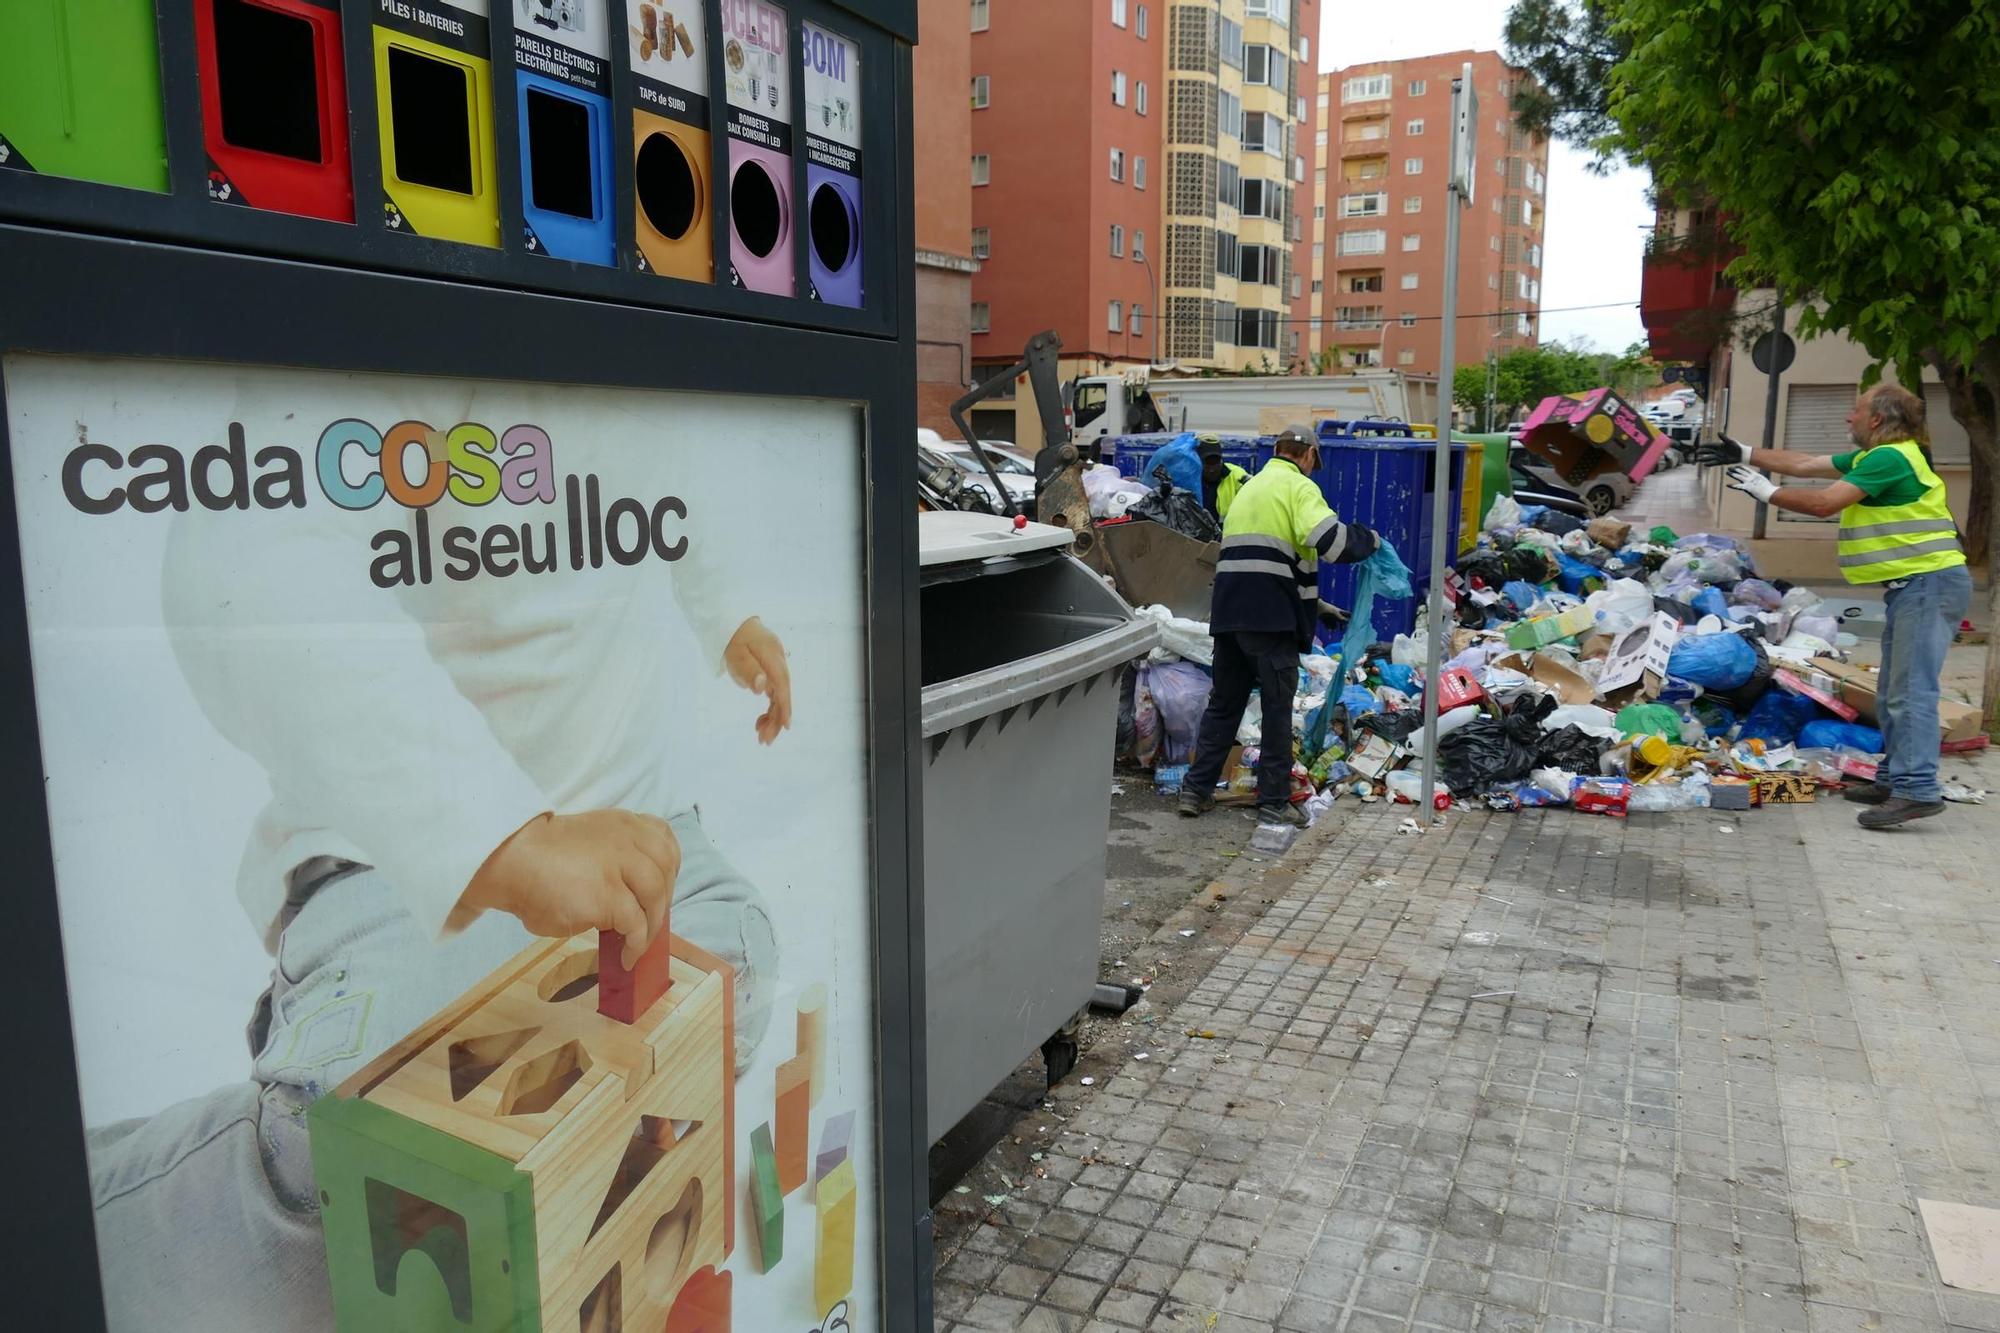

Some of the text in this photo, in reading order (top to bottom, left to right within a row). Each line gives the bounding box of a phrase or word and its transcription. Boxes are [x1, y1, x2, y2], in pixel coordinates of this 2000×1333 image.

[381, 0, 464, 36] PILES i BATERIES
[515, 34, 600, 75] PARELLS ELÈCTRICS i
[515, 50, 569, 79] ELECTRÒNICS
[802, 26, 846, 83] BOM
[639, 86, 686, 112] TAPS de SURO
[727, 121, 741, 136] BAIX
[741, 126, 766, 143] CONSUM
[770, 135, 781, 148] LED
[738, 112, 769, 132] BOMBETES
[811, 149, 851, 171] INCANDESCENTS
[62, 418, 556, 515] cada cosa
[369, 473, 689, 588] al seu lloc
